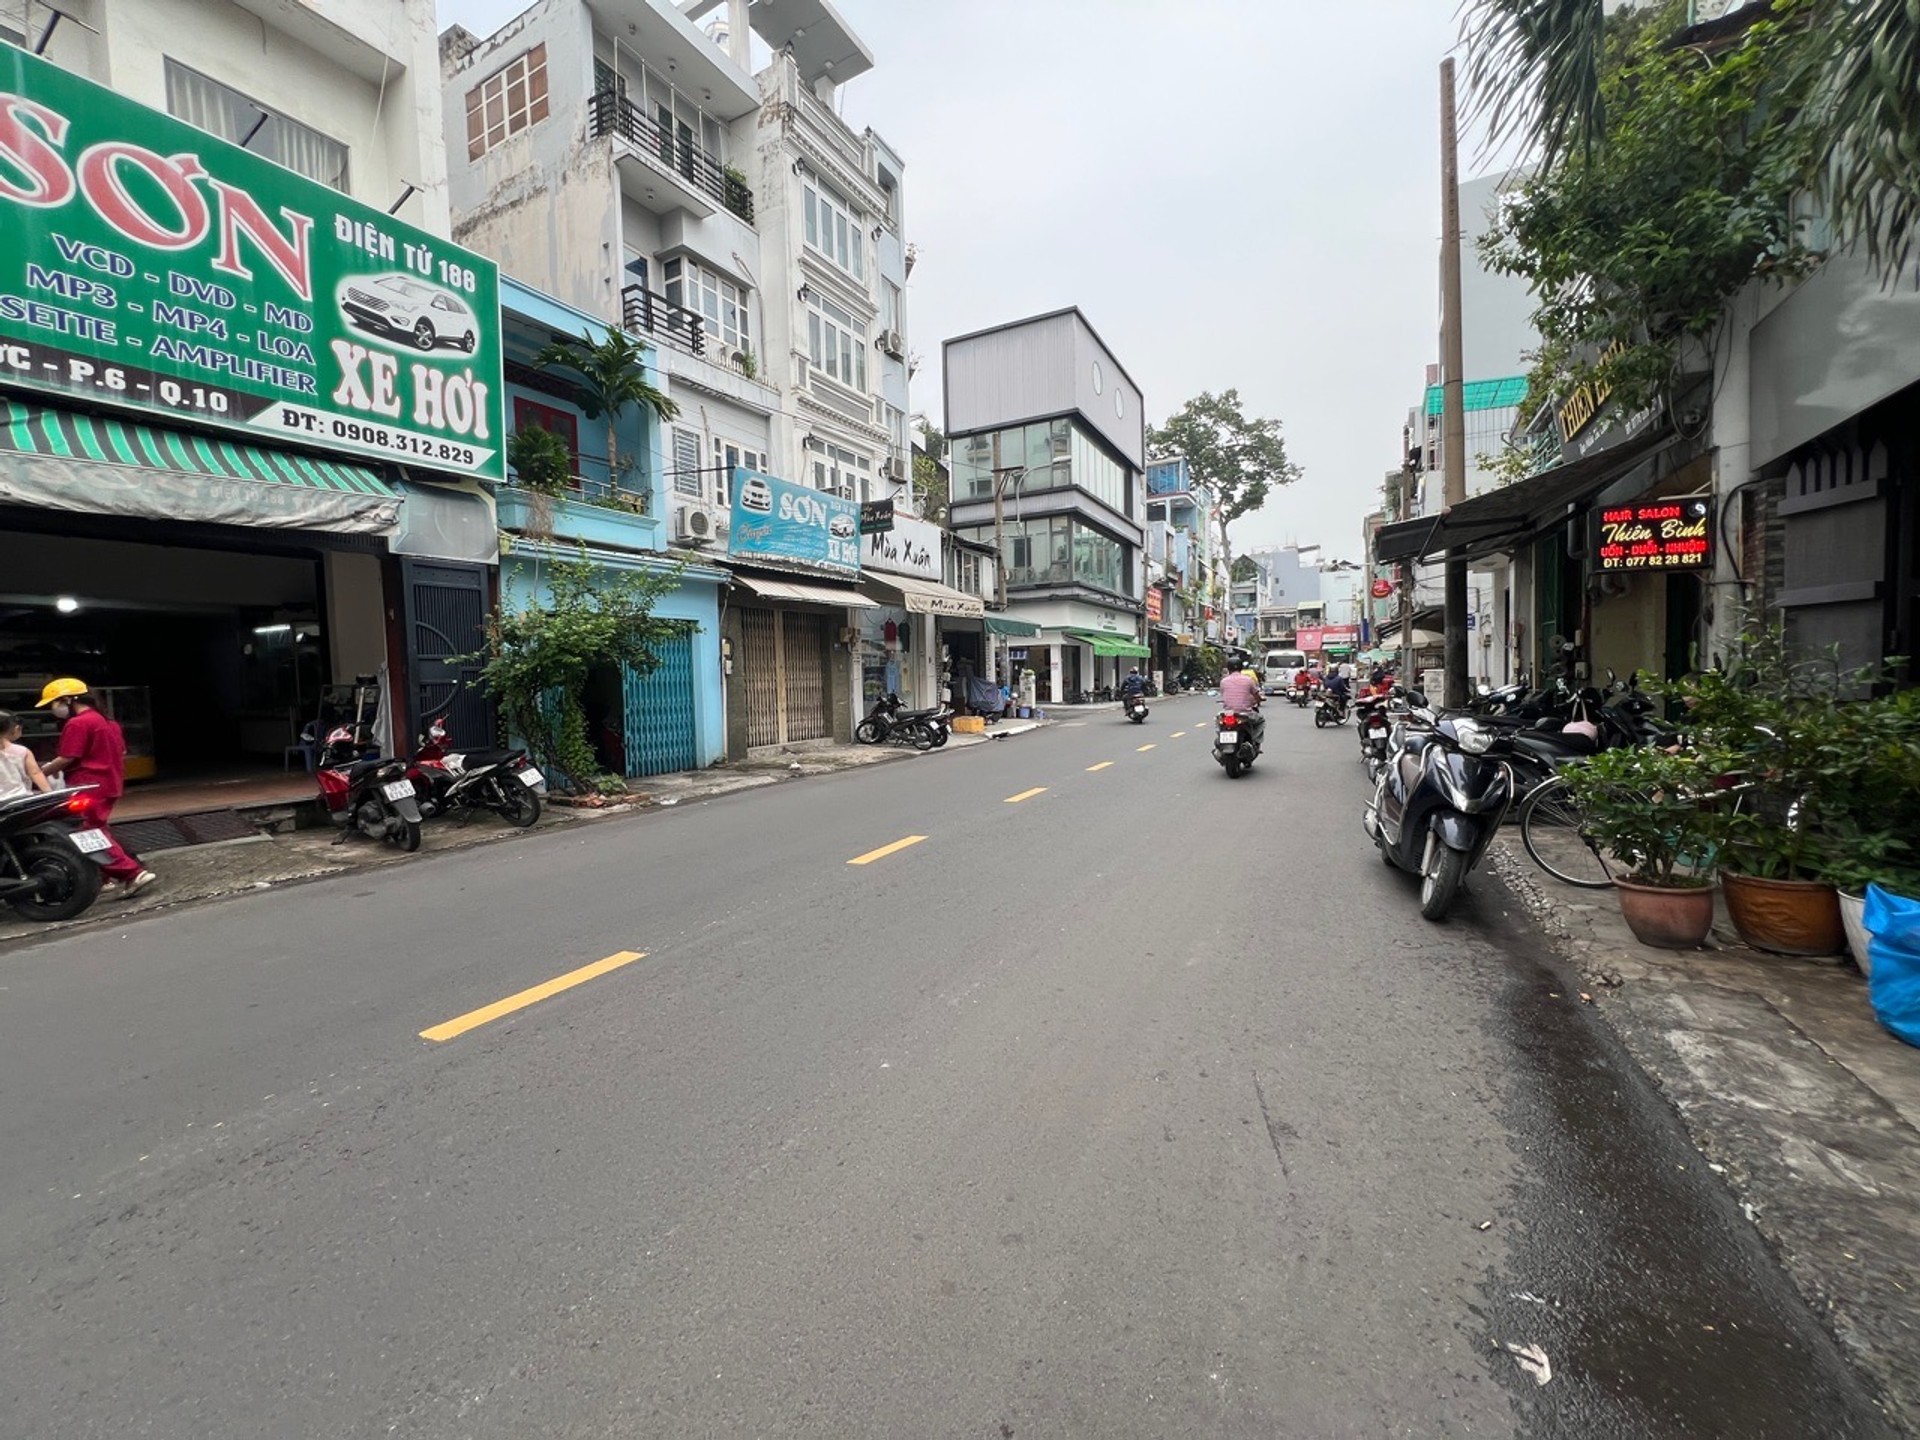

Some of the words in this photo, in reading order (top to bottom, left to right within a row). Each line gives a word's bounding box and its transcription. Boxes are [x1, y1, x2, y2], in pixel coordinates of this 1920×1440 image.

[0, 93, 314, 300] SƠN
[334, 213, 395, 262] ĐIỆN
[403, 242, 433, 276] TỬ
[438, 260, 476, 292] 188
[52, 233, 135, 278] VCD
[169, 271, 236, 309] DVD
[265, 302, 313, 333] MD
[26, 263, 117, 309] MP3
[153, 301, 228, 341] MP4
[258, 332, 316, 366] LOA
[0, 295, 118, 346] SETTE
[150, 335, 319, 396] AMPLIFIER
[69, 359, 127, 390] P.6
[159, 380, 228, 413] Q.10
[331, 339, 400, 419] XE
[411, 365, 490, 440] HƠI
[282, 408, 325, 433] ĐT:
[332, 419, 474, 465] 0908.312.829
[779, 492, 827, 530] SƠN
[1602, 522, 1652, 544] Thiên
[1660, 517, 1706, 538] Bình
[1603, 509, 1632, 521] HAIR
[1638, 507, 1680, 519] SALON
[871, 532, 897, 562] Mùa
[903, 538, 931, 568] Xuân
[1603, 558, 1623, 568] ĐT:
[1626, 556, 1647, 566] 077
[1649, 555, 1663, 565] 82
[1665, 555, 1679, 564] 28
[1682, 554, 1702, 563] 821
